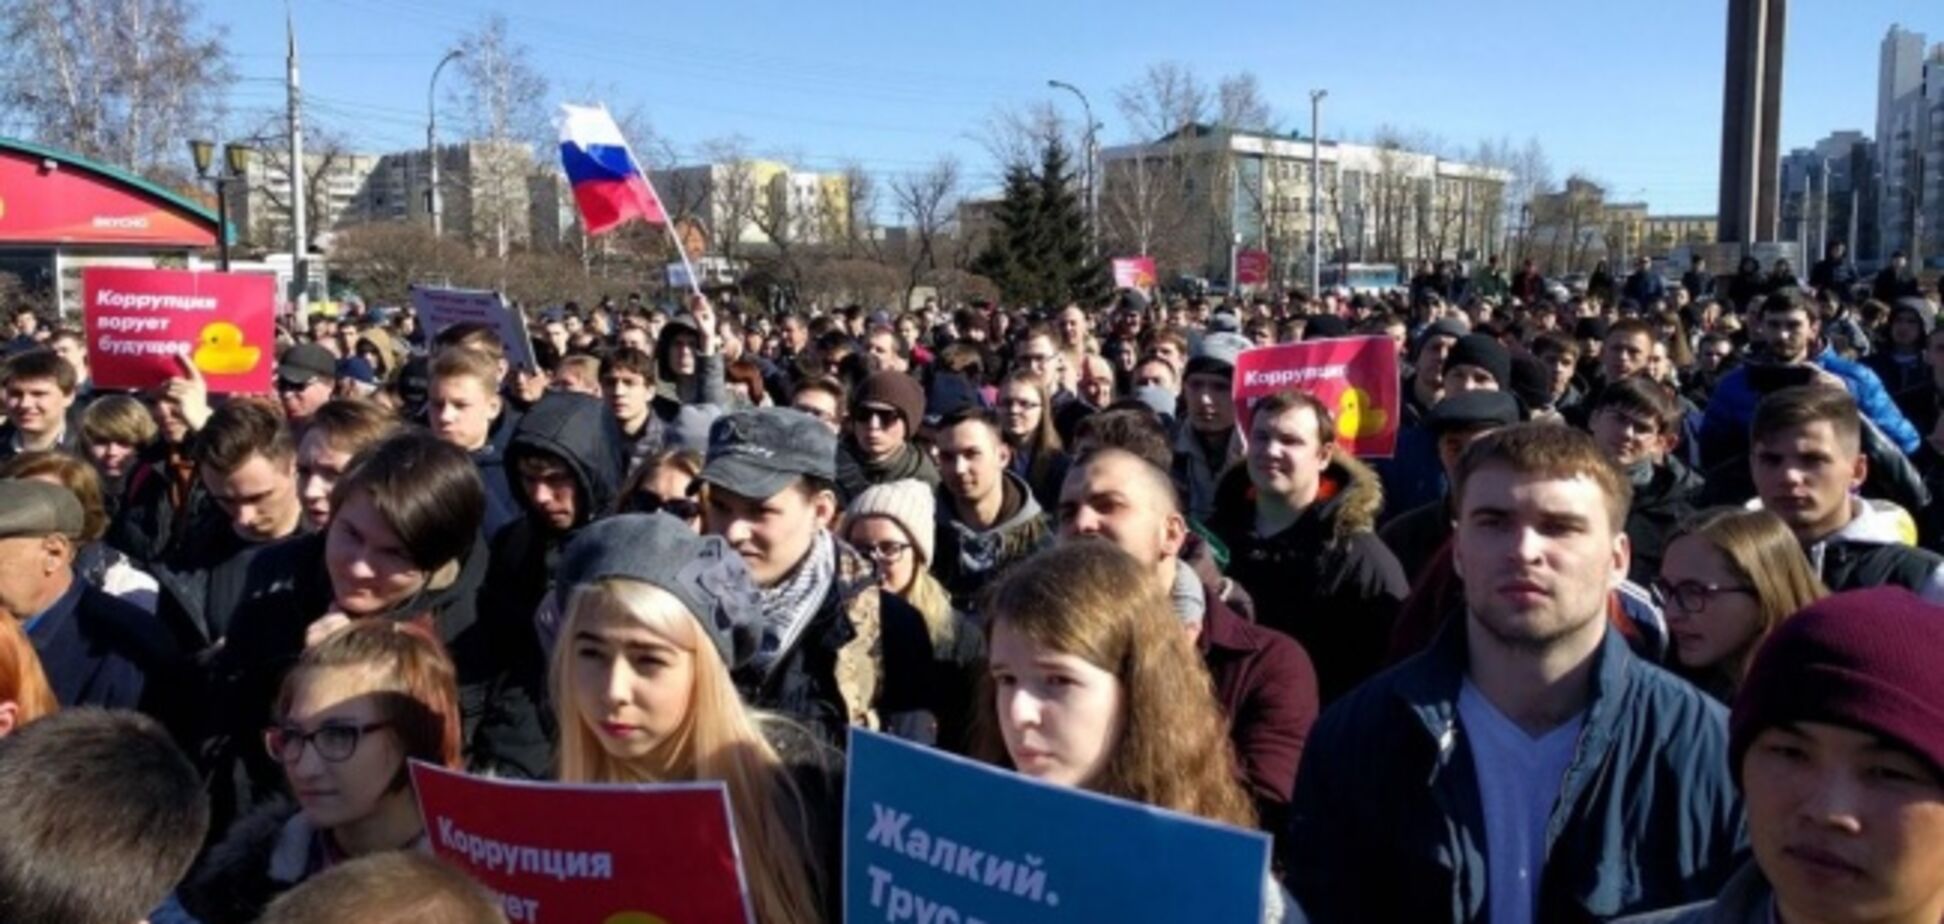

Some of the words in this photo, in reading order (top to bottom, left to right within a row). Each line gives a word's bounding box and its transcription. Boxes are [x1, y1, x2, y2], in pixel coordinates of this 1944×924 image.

[96, 290, 217, 310] Коррупция
[97, 316, 171, 332] ворует
[99, 334, 191, 355] будущее
[437, 815, 614, 880] Коррупция
[866, 802, 1060, 907] Жалкий.
